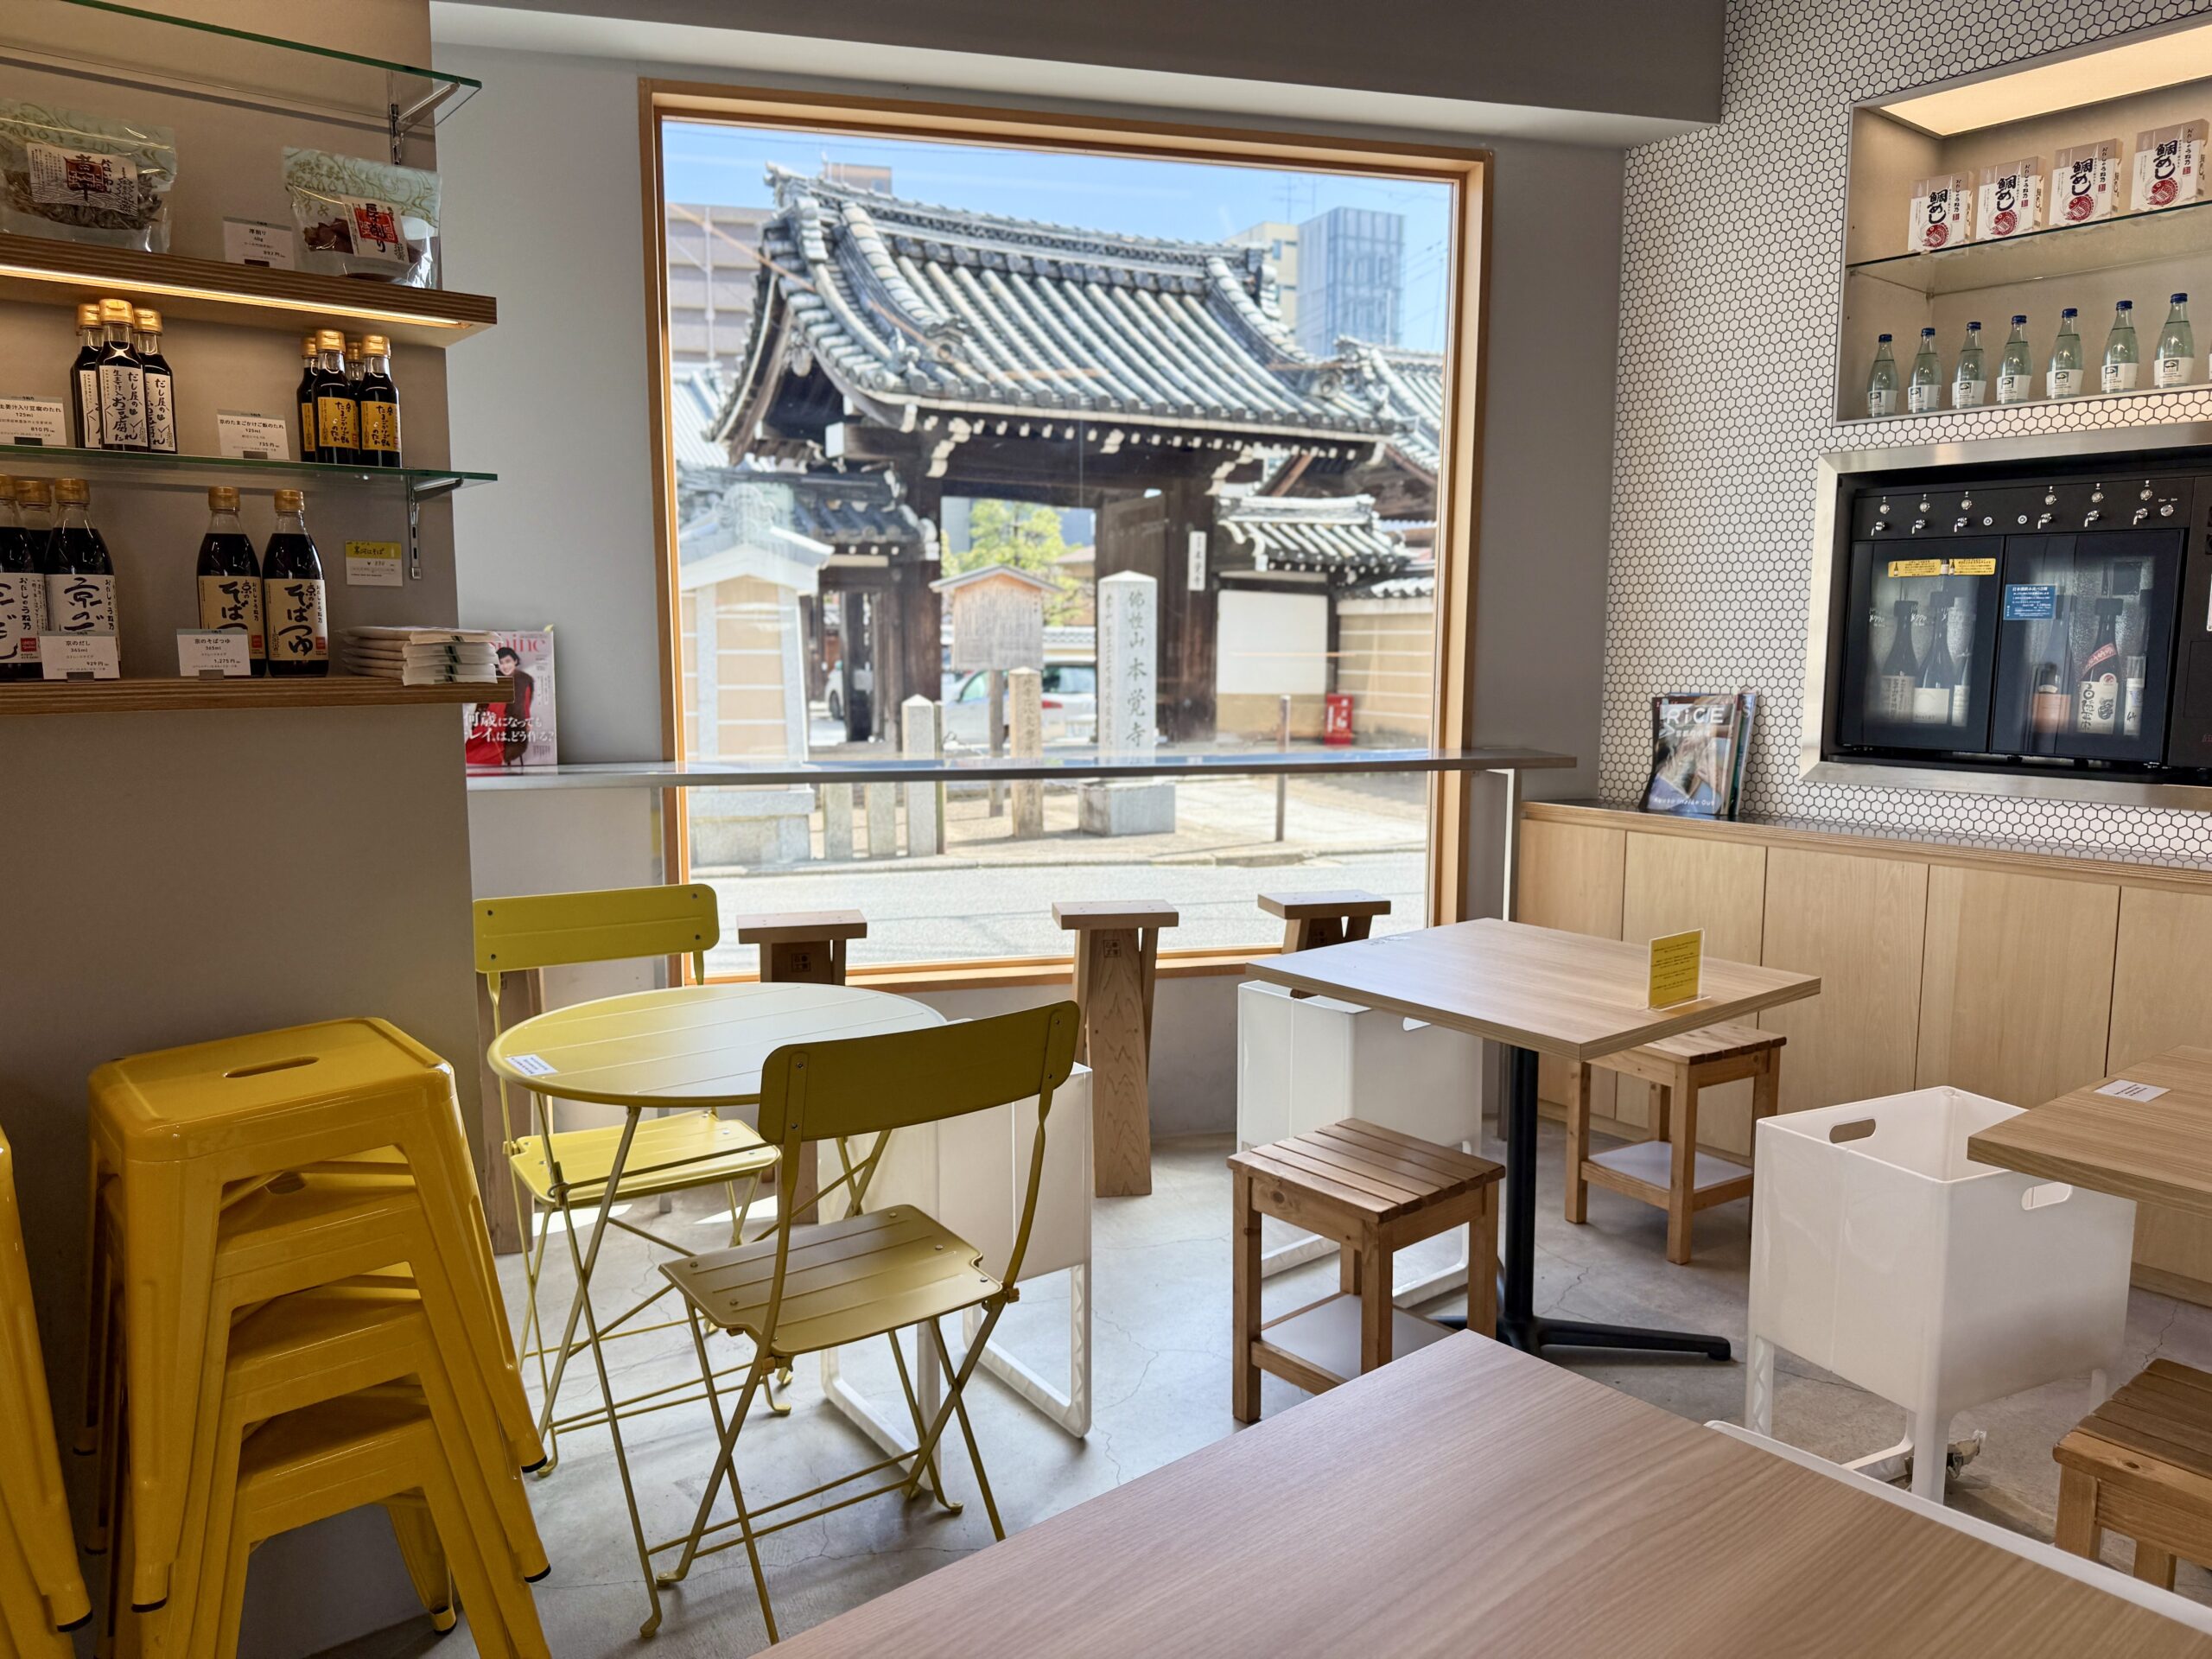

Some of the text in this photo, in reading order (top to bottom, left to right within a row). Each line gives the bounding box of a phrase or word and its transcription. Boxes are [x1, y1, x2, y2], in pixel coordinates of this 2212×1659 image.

[2070, 158, 2094, 196] 鯛めし
[2153, 140, 2177, 180] 鯛めし
[1927, 189, 1948, 224] 鯛めし
[1995, 175, 2017, 211] 鯛めし
[365, 203, 386, 253] 厚削り
[127, 372, 138, 408] だし屋の
[278, 583, 315, 656] そばつゆ
[464, 711, 543, 728] 何歳になっても
[1666, 707, 1725, 724] RiCE
